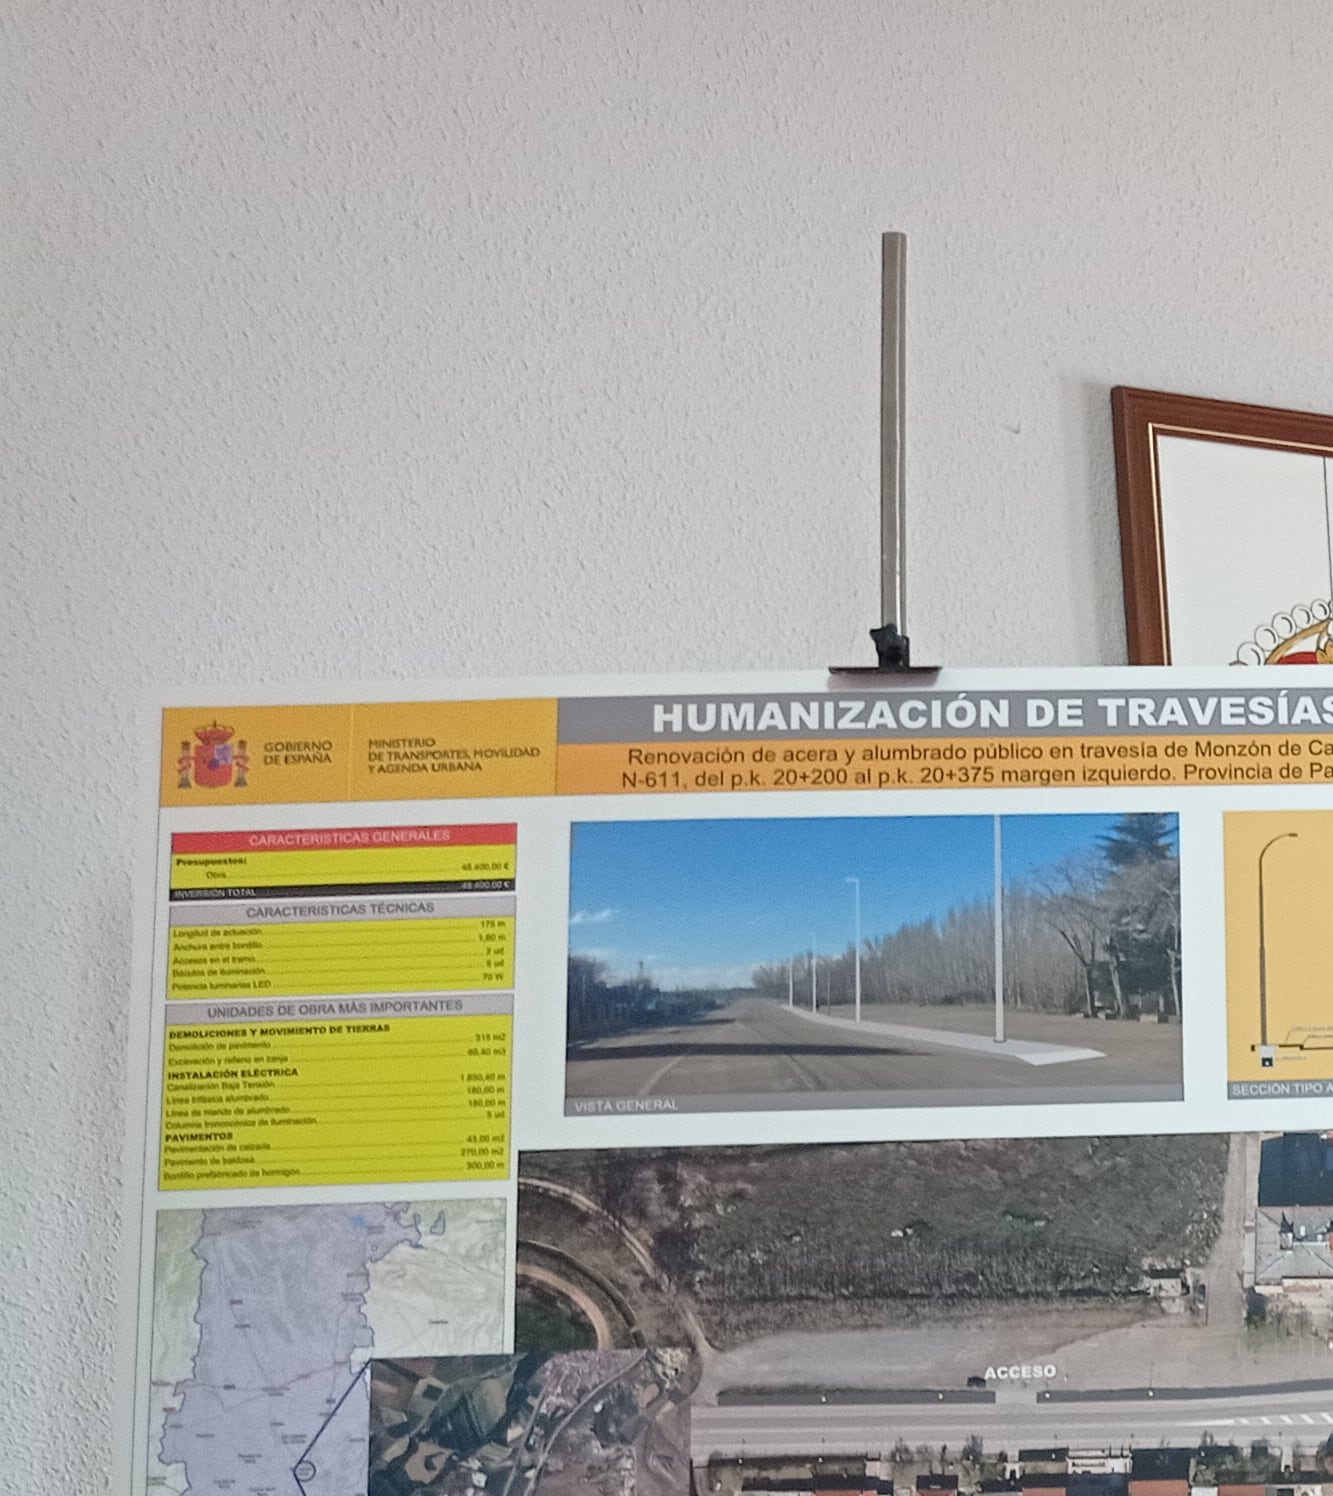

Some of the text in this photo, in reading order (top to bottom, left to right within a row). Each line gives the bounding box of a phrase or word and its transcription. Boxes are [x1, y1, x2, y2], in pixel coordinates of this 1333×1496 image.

[653, 693, 1010, 732] HUMANIZACIÓN
[1027, 698, 1084, 727] DE
[264, 740, 333, 753] GOBIERNO
[368, 738, 436, 749] MINISTERIO
[368, 751, 386, 763] DE
[473, 747, 541, 759] MOVILIDAD
[628, 746, 745, 766] Renovación
[752, 747, 777, 763] de
[783, 750, 837, 763] acera
[844, 750, 856, 765] y
[862, 743, 967, 761] alumbrado
[974, 741, 1044, 763] público
[1049, 745, 1074, 759] en
[1080, 740, 1158, 759] travesía
[1164, 741, 1189, 758] de
[1196, 740, 1272, 758] Monzón
[1278, 740, 1303, 758] de
[264, 753, 332, 766] DE ESPAÑA
[368, 762, 483, 774] Y AGENDA URBANA
[622, 770, 688, 789] N-611,
[695, 769, 724, 787] del
[731, 770, 766, 790] p.k.
[773, 769, 847, 786] 20+200
[854, 768, 872, 785] al
[878, 767, 914, 788] p.k.
[920, 766, 994, 784] 20+375
[1002, 768, 1073, 786] margen
[1082, 764, 1176, 786] izquierdo.
[1184, 762, 1273, 781] Provincia
[1280, 763, 1302, 780] de
[372, 829, 451, 842] GENERALES
[227, 888, 257, 897] TOTAL
[370, 900, 436, 914] TÉCNICAS
[173, 928, 209, 938] Longitud
[210, 928, 221, 936] de
[173, 942, 208, 950] Anchura
[209, 942, 231, 950] entre
[172, 957, 208, 965] Accesos
[207, 968, 219, 977] de
[172, 982, 209, 991] Potencia
[253, 980, 272, 989] LED
[495, 972, 504, 980] W
[207, 999, 463, 1019] UNIDADES DE OBRA MÁS IMPORTANTES
[169, 1024, 391, 1039] DEMOLICIONES Y MOVIMIENTO DE TIERRAS
[216, 1042, 227, 1050] de
[253, 1056, 265, 1064] en
[167, 1069, 238, 1080] INSTALACIÓN
[1293, 1083, 1323, 1095] TIPO
[575, 1099, 679, 1113] VISTA GENERAL
[165, 1132, 234, 1143] PAVIMENTOS
[226, 1144, 238, 1152] de
[209, 1157, 221, 1166] de
[249, 1169, 261, 1178] de
[984, 1364, 1057, 1380] ACCESO
